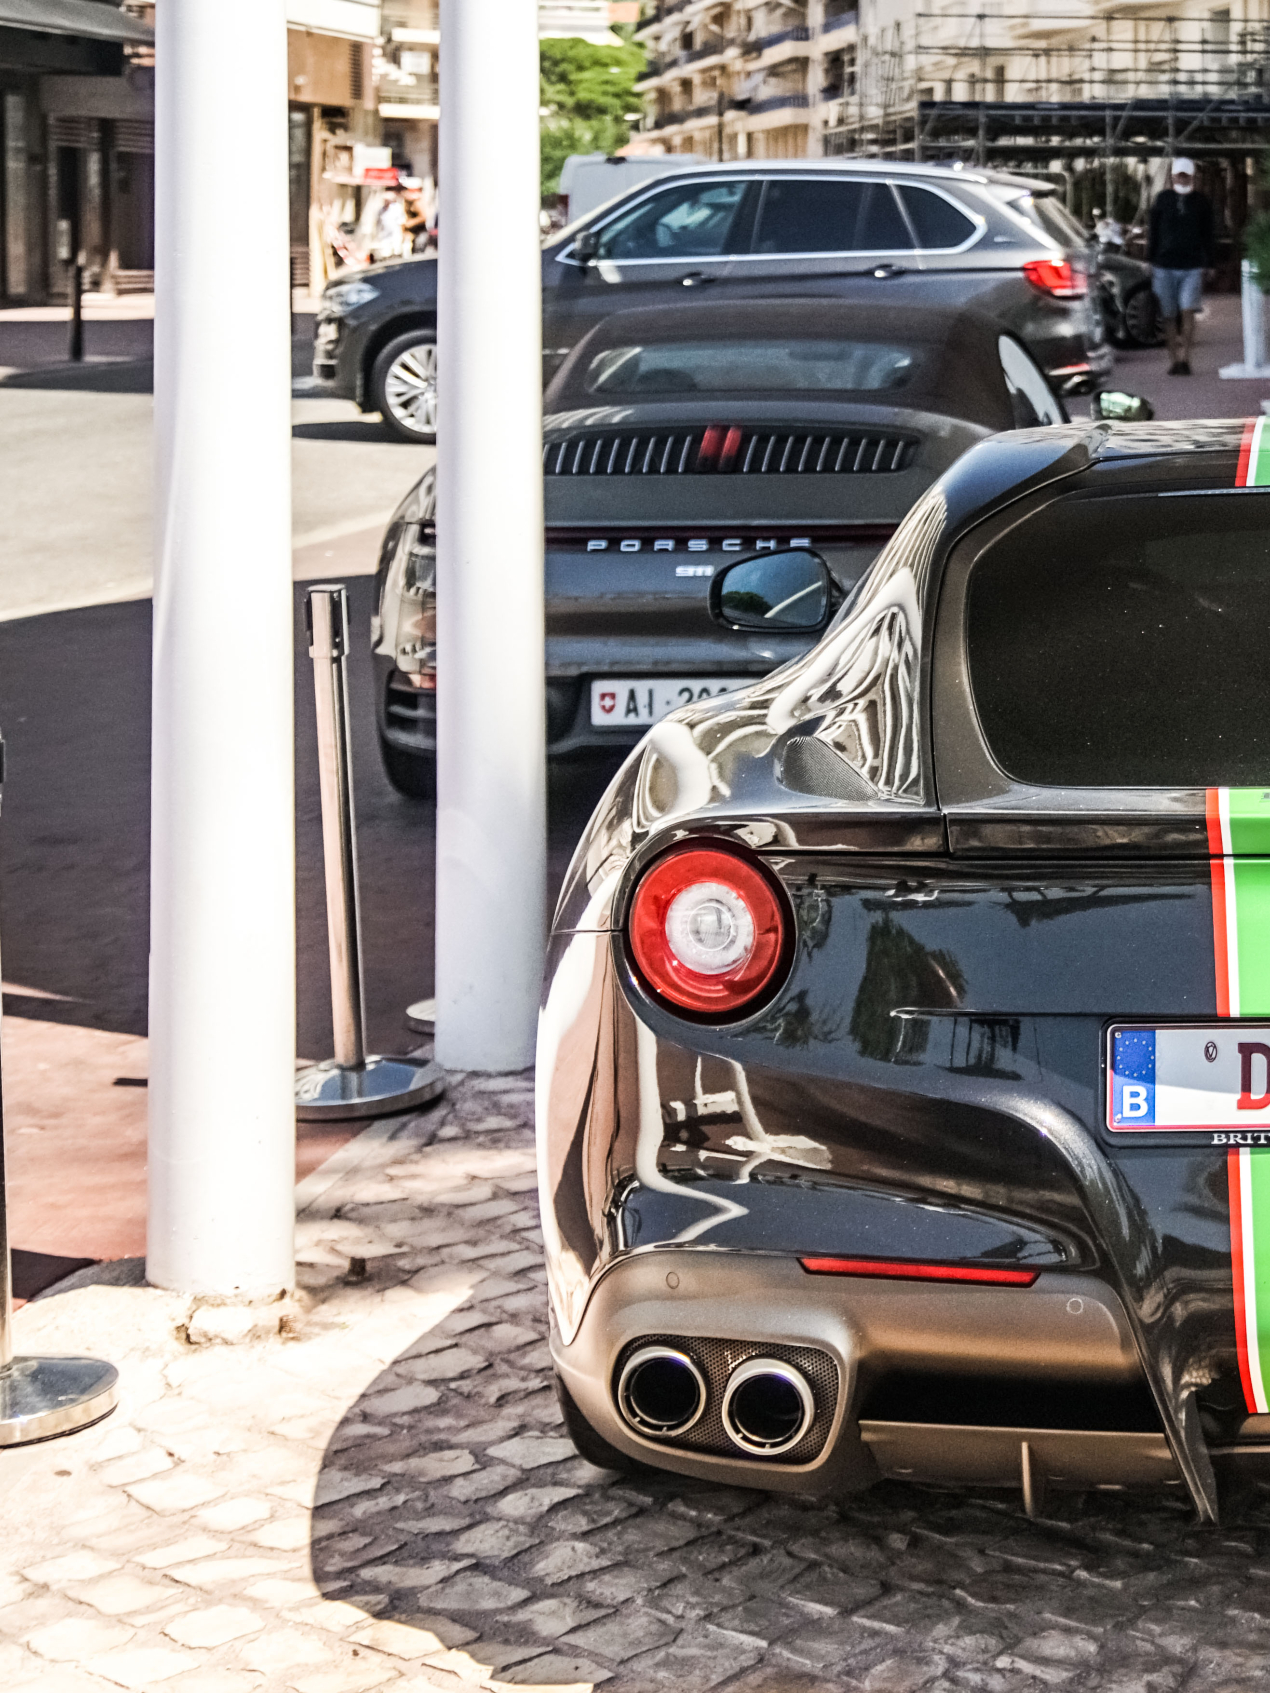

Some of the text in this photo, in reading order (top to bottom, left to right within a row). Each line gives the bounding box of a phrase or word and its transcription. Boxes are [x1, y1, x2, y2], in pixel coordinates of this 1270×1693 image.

[587, 538, 811, 552] PORSCHE
[675, 564, 714, 577] 911
[1122, 1085, 1149, 1118] B
